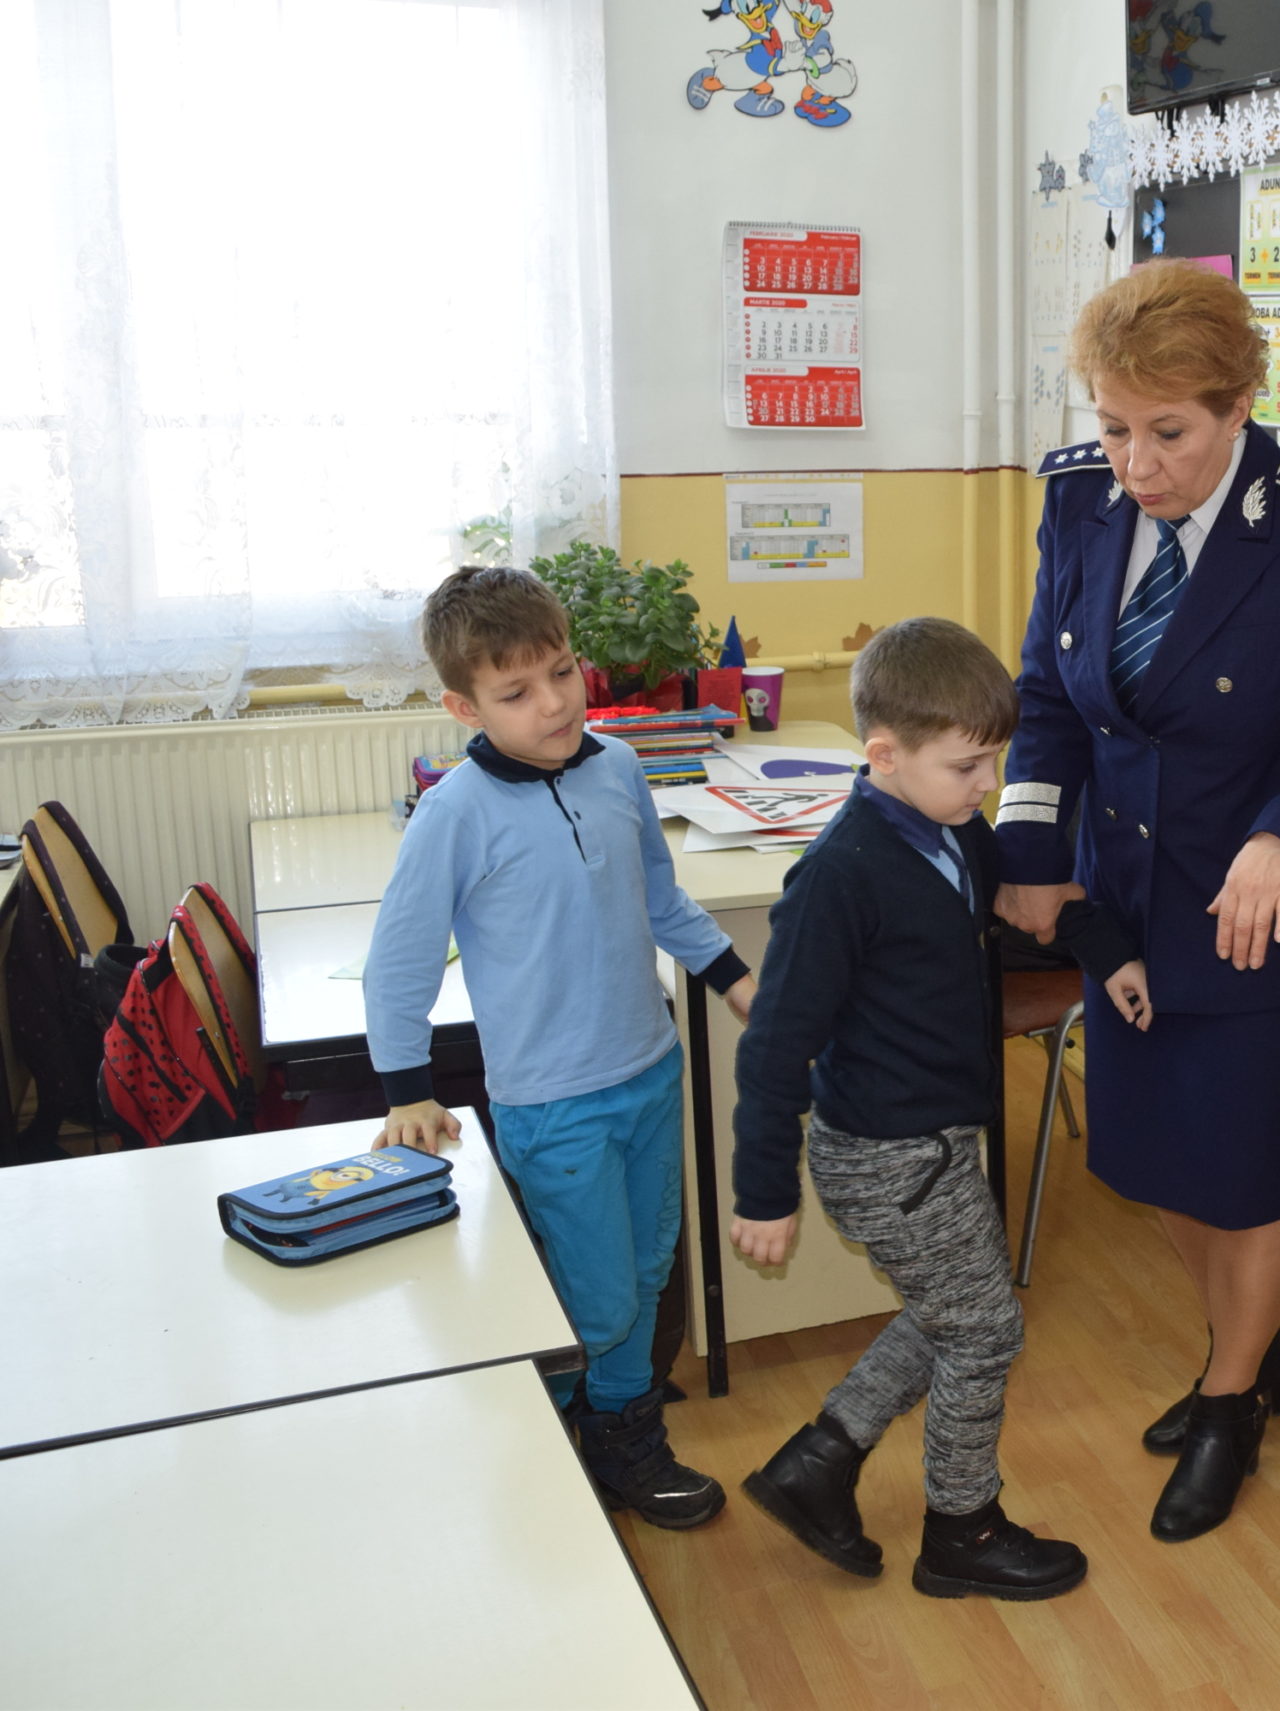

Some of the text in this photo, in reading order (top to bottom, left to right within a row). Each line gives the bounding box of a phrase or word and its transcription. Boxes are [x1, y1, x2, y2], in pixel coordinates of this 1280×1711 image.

[1250, 247, 1256, 263] 3
[1273, 246, 1280, 262] 2
[352, 1154, 411, 1177] BELLO!
